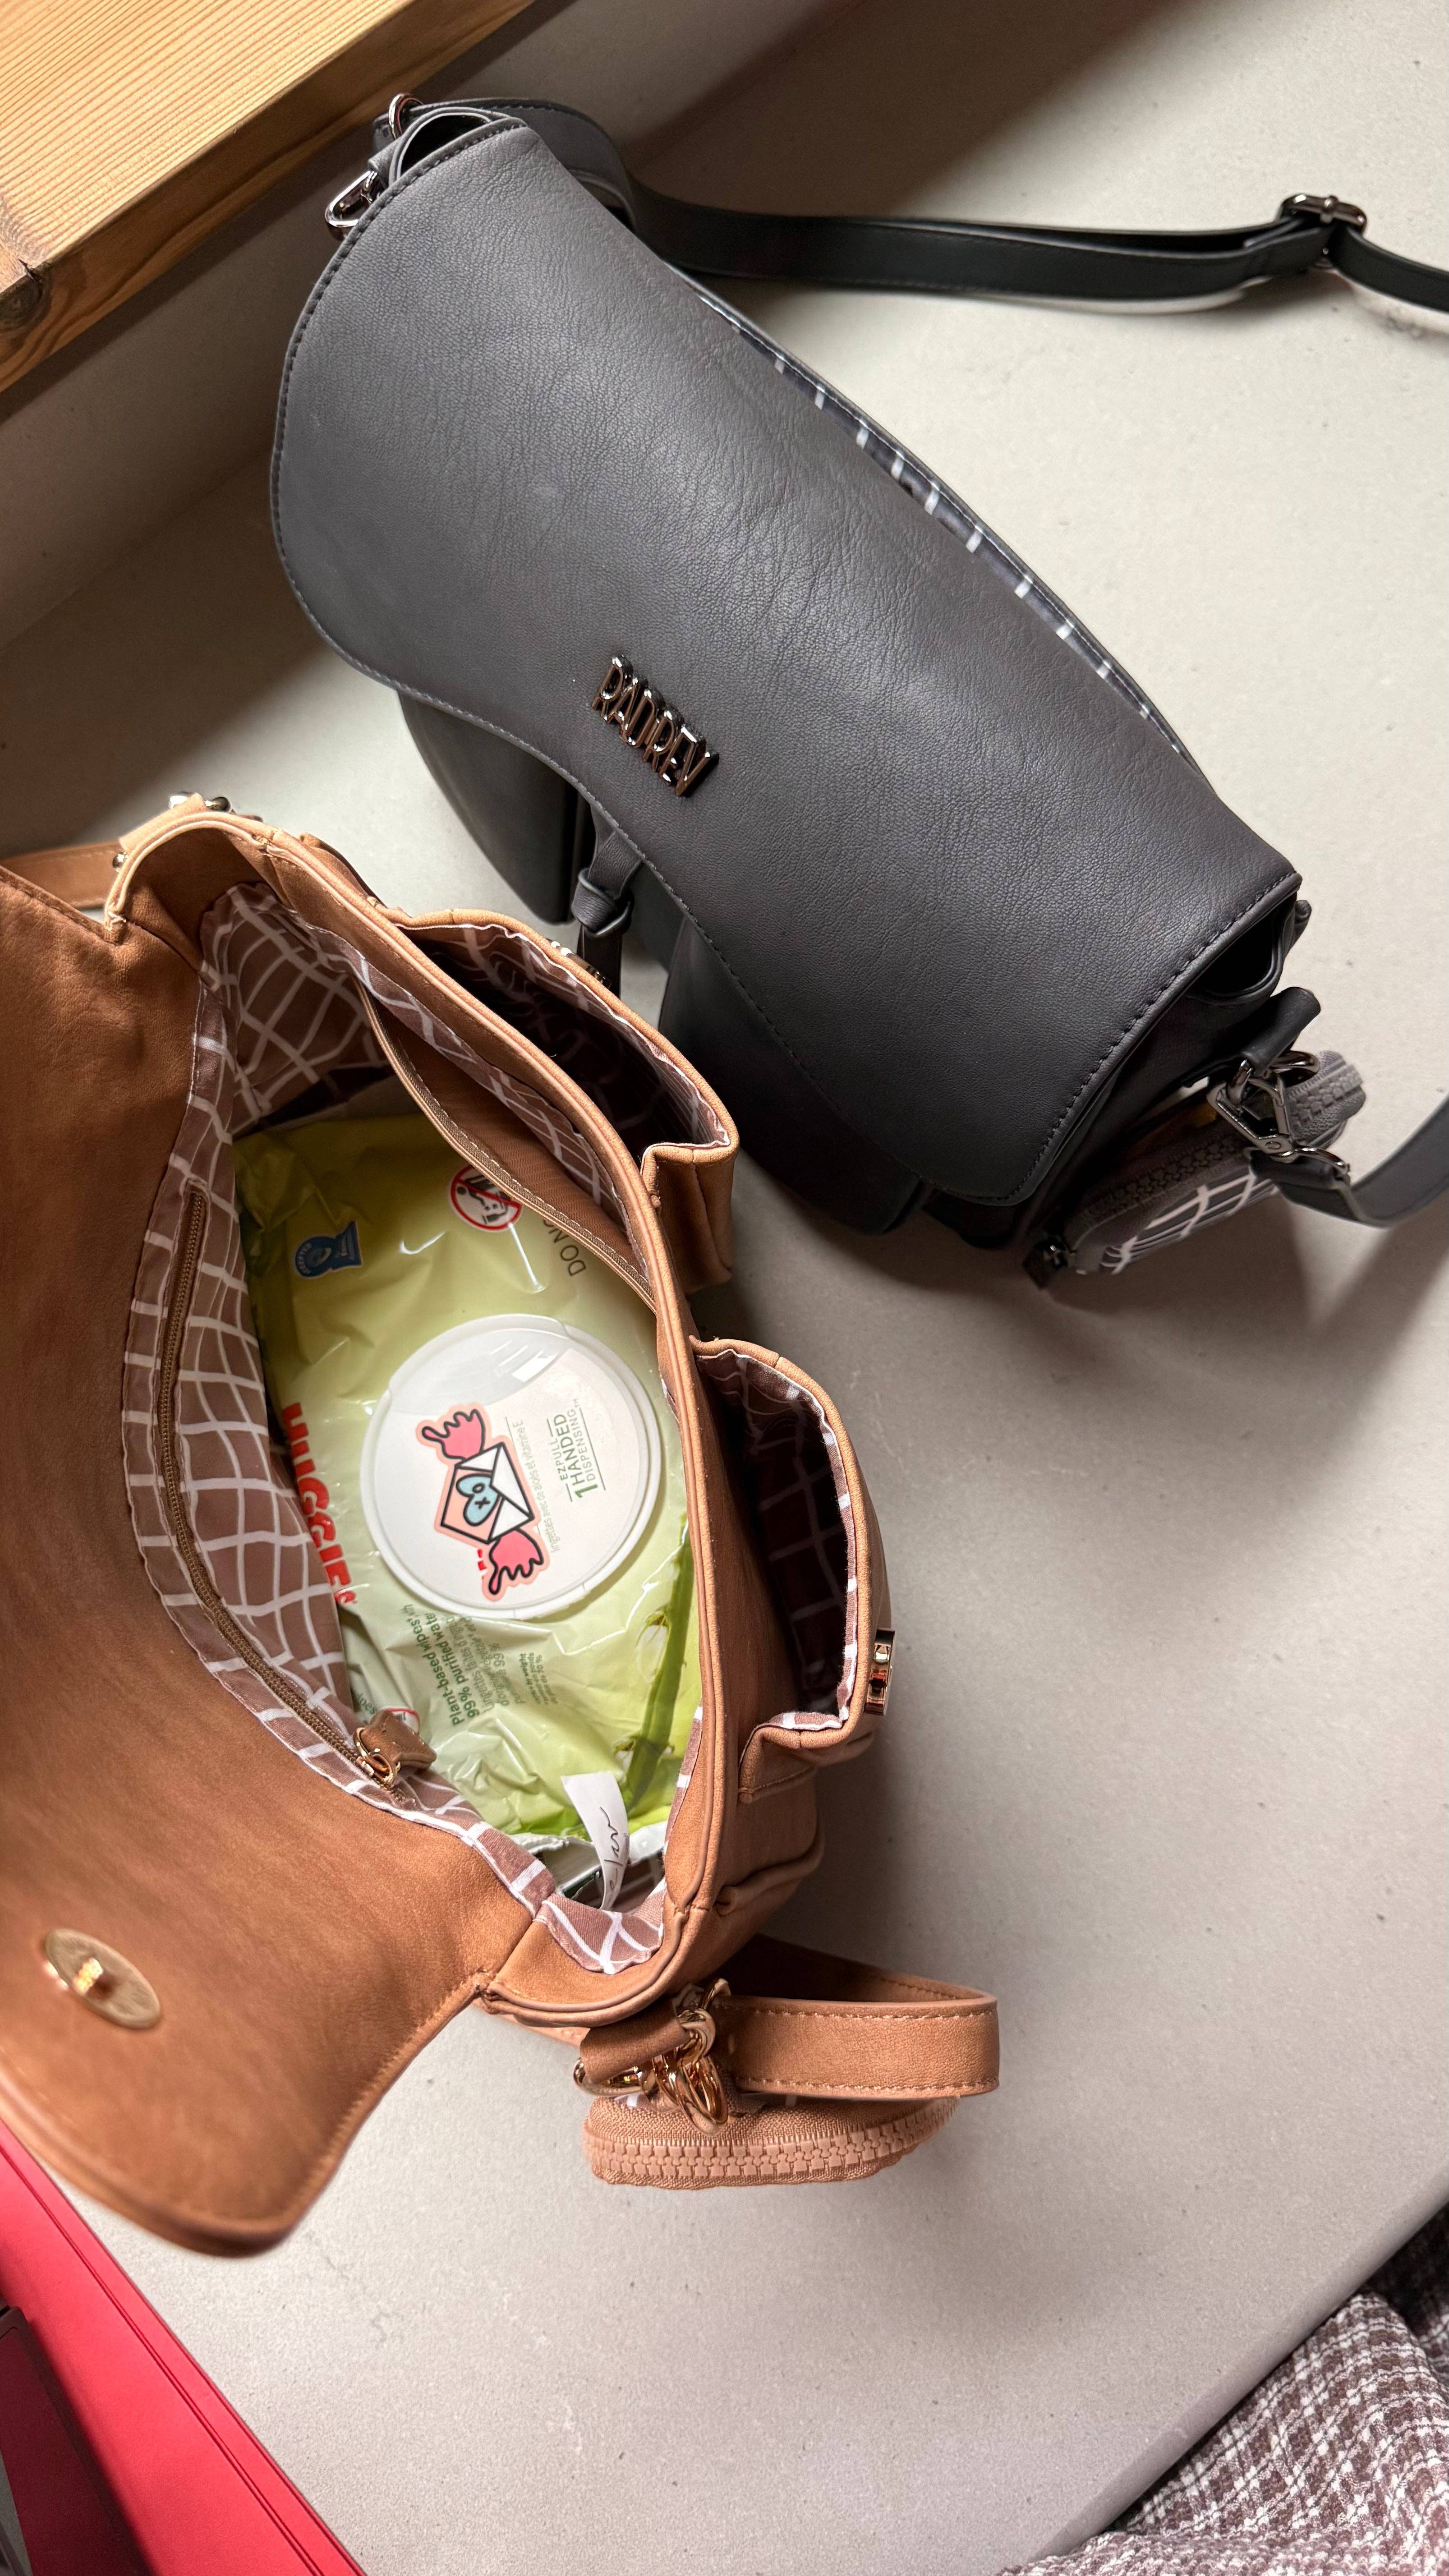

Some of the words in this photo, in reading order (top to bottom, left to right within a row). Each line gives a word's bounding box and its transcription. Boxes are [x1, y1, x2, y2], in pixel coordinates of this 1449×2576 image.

[560, 1245, 586, 1277] DO
[550, 1437, 568, 1481] EZPULL
[553, 1413, 585, 1486] HANDED
[575, 1483, 598, 1499] 1
[436, 1640, 469, 1686] purified
[493, 1652, 506, 1667] 99
[423, 1651, 465, 1726] Plant-based
[458, 1685, 480, 1718] 99%
